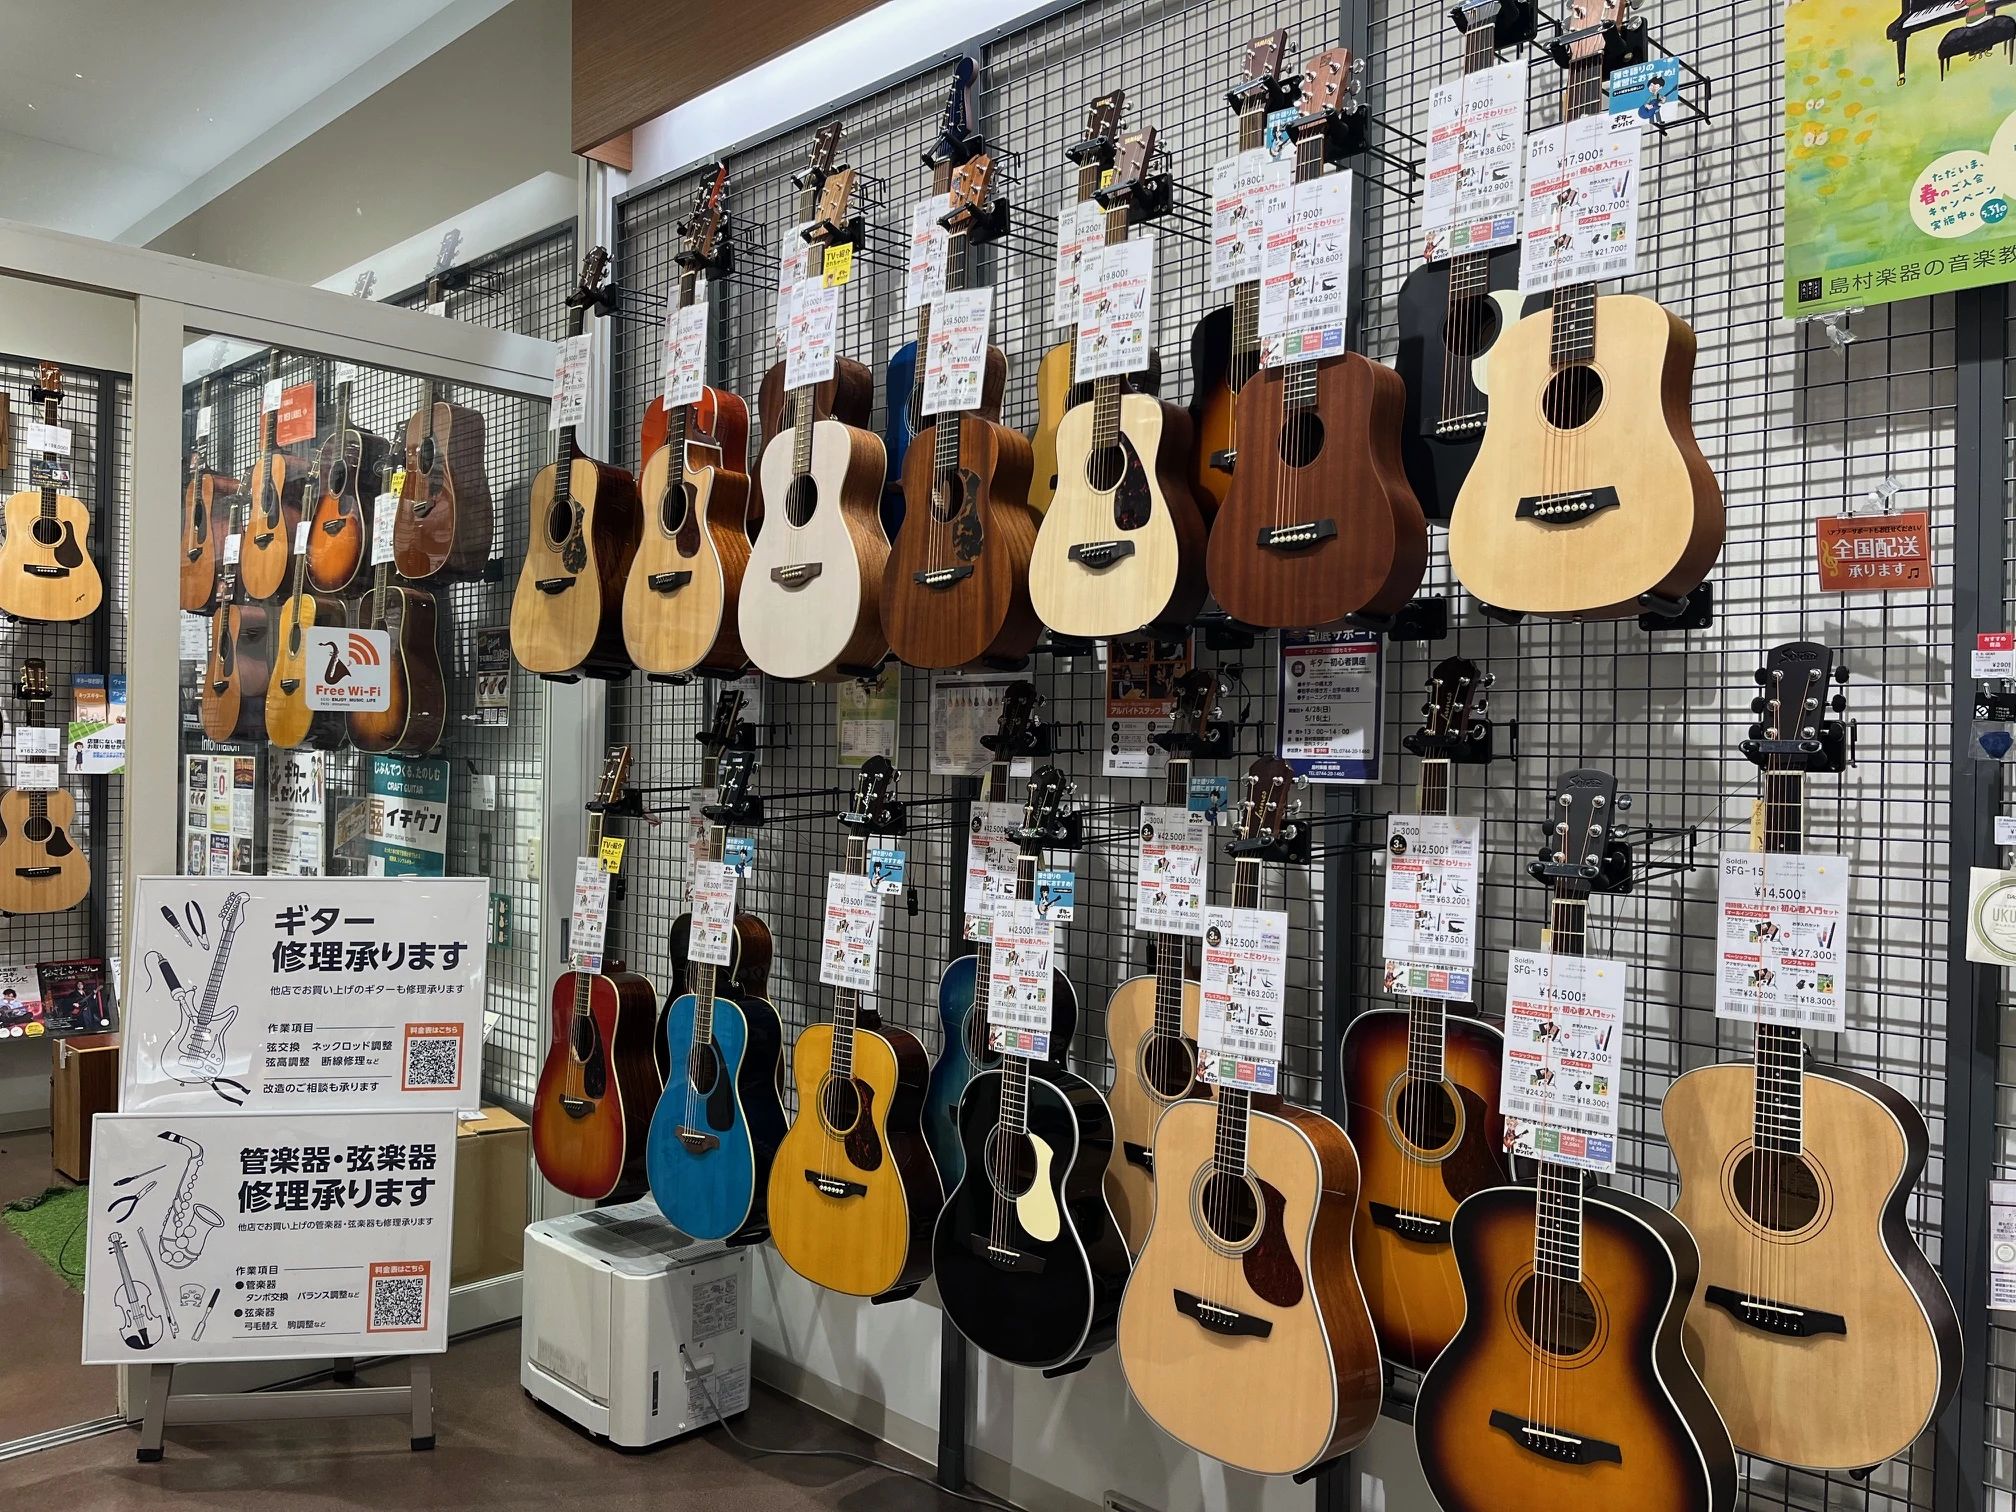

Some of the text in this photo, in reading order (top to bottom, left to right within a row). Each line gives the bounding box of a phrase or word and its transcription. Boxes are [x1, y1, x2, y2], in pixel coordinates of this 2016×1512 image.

[1532, 143, 1554, 158] DT1S
[1928, 186, 1996, 216] キャンペーン
[1832, 535, 1921, 560] 全国配送
[1848, 562, 1906, 578] 承ります
[315, 685, 381, 697] Free Wi-Fi
[1111, 707, 1161, 715] アルバイトスタッフ
[386, 806, 442, 834] イチゲン
[1725, 857, 1748, 865] Soldin
[1725, 866, 1764, 877] SFG-15
[274, 905, 375, 937] ギター
[272, 941, 468, 973] 修理承ります
[1514, 956, 1535, 965] Soldin
[1513, 964, 1549, 977] SFG-15
[270, 984, 465, 996] 他店でお買い上げのギターも修理承ります
[267, 1023, 313, 1033] 作業項目
[410, 1026, 458, 1034] 料金表はこちら
[266, 1040, 393, 1053] 弦交換 ネックロッド調整
[265, 1055, 379, 1067] 弦高調整 断線修理など
[263, 1082, 379, 1093] 改造のご相談も承ります
[239, 1144, 437, 1175] 管楽器・弦楽器
[238, 1178, 437, 1213] 修理承ります
[238, 1217, 434, 1232] 他店でお買い上げの管楽器・弦楽器も修理承ります
[235, 1265, 279, 1276] 作業項目
[375, 1265, 424, 1274] 料金表はこちら
[246, 1280, 276, 1290] 管楽器
[246, 1290, 360, 1302] タンポ交換 バランス調整など
[244, 1307, 275, 1317] 弦楽器
[244, 1320, 279, 1331] 弓毛替え
